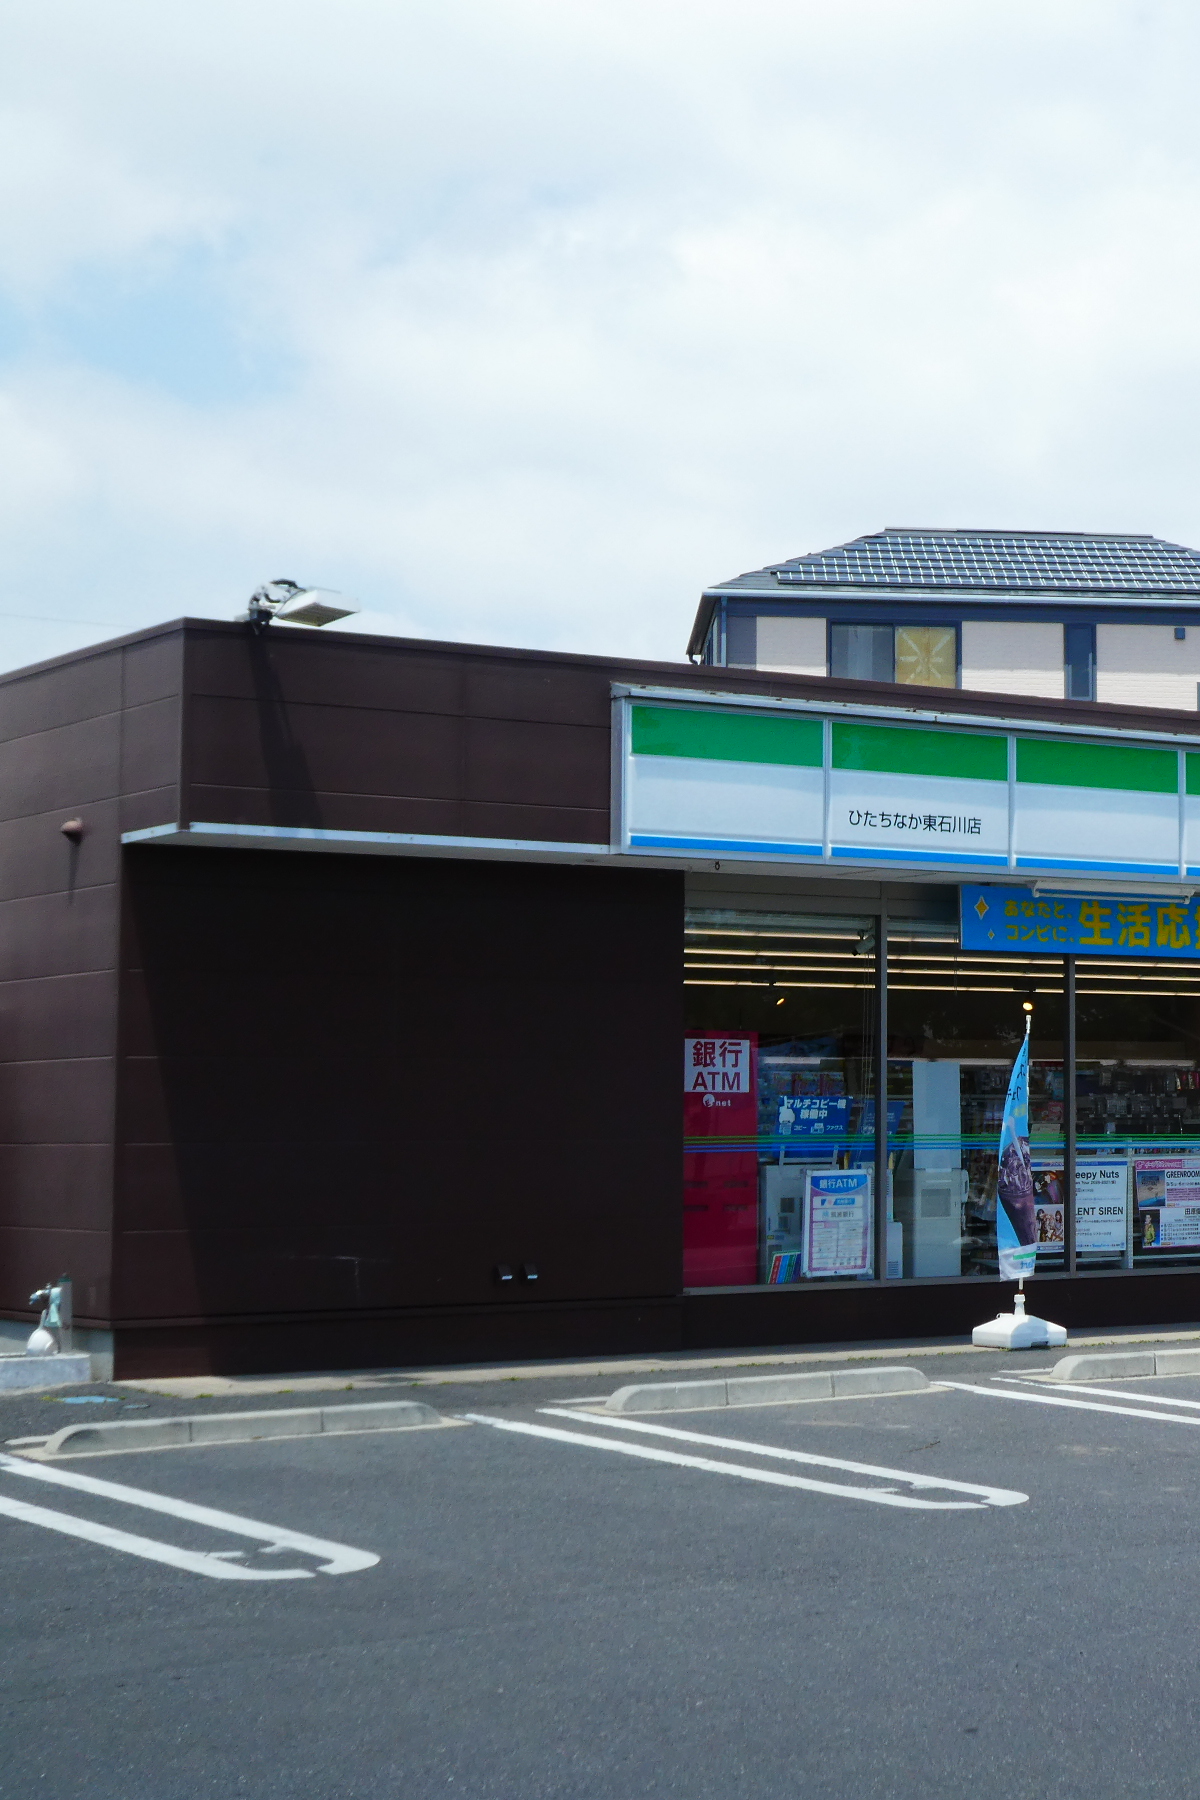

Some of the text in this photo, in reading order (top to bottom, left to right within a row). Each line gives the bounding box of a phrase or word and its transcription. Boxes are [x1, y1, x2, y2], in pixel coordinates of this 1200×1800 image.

[848, 809, 982, 835] ひたちなか東石川店
[1004, 899, 1074, 920] あなたと、
[1005, 923, 1076, 943] コンビに、
[692, 1039, 743, 1069] 銀行
[692, 1071, 741, 1091] ATM
[819, 1178, 858, 1189] 銀行ATM
[1075, 1169, 1120, 1180] eepy Nuts
[1165, 1170, 1200, 1179] GREENROOM
[1075, 1206, 1124, 1216] ENT SIREN
